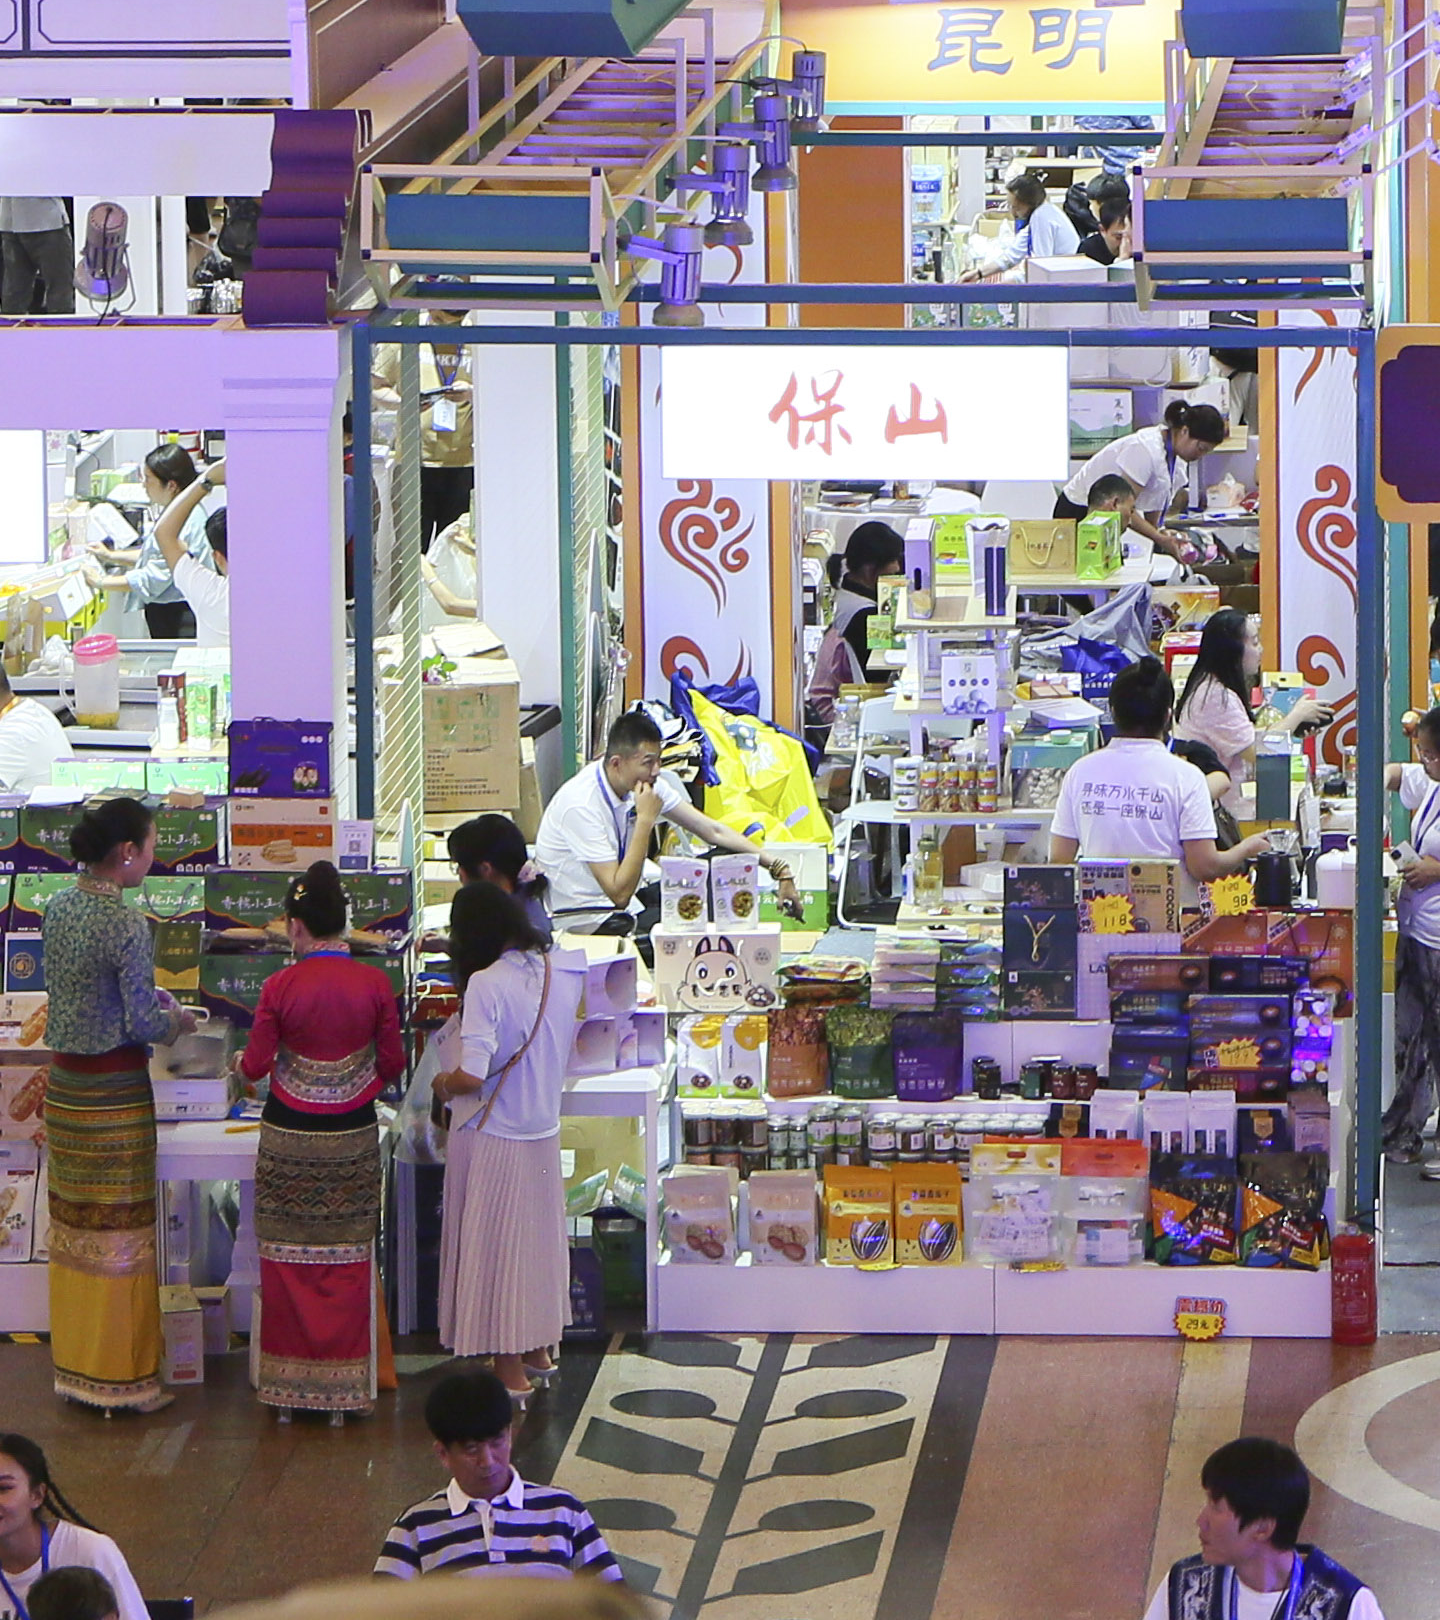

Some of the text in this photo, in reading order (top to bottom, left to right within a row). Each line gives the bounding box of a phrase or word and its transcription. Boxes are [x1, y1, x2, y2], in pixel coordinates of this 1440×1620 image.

[927, 7, 1116, 75] 昆明
[767, 369, 950, 455] 保山
[1082, 783, 1165, 803] 寻味万水千山
[1081, 802, 1165, 820] 还是一座保山
[1232, 894, 1248, 909] 98
[1103, 913, 1128, 928] 118
